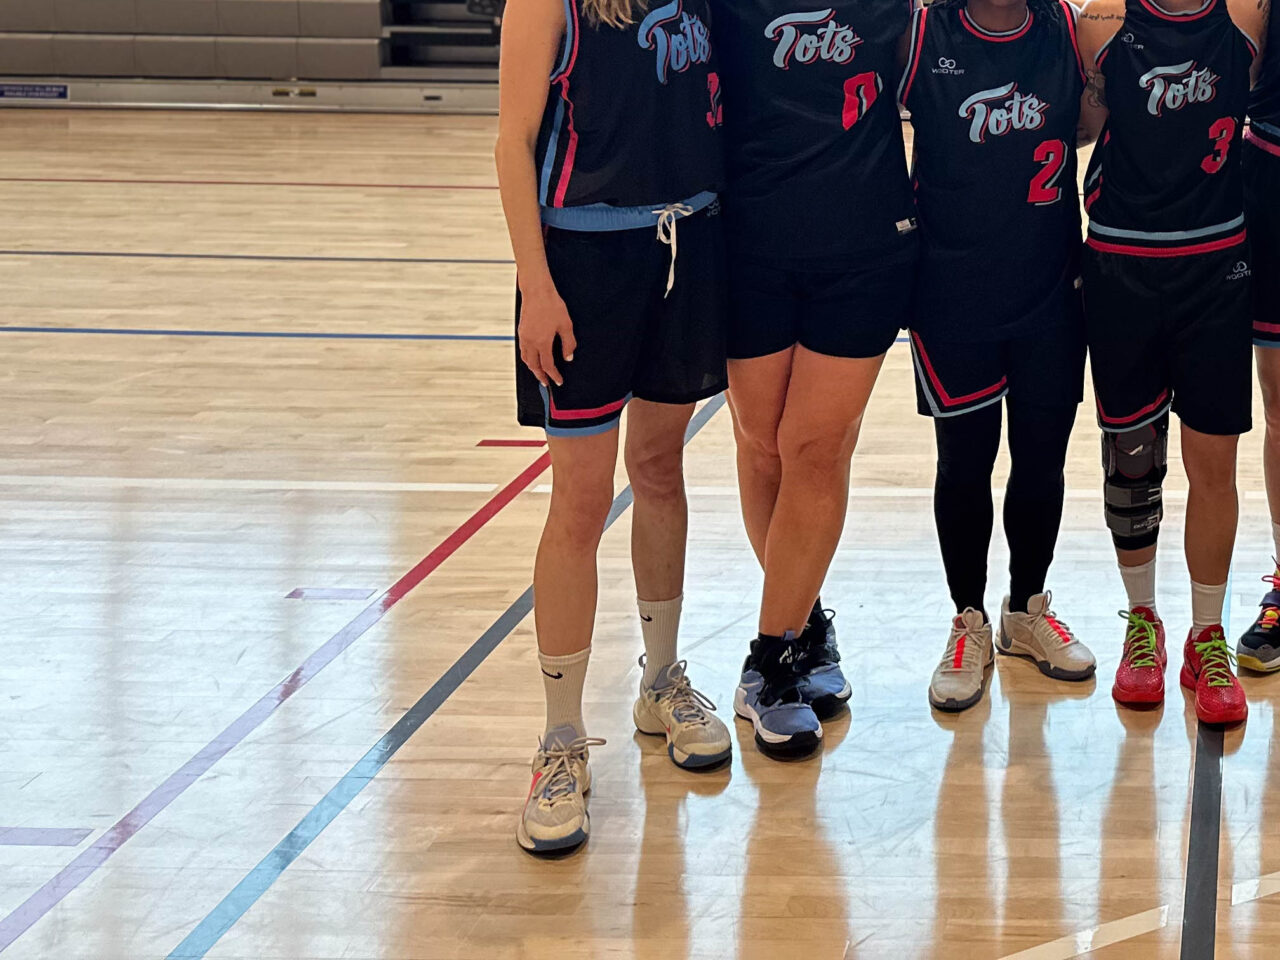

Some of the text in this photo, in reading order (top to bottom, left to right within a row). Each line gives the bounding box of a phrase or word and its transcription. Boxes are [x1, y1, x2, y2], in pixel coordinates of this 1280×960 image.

[764, 8, 864, 70] Tots
[958, 81, 1050, 144] Tots
[1139, 59, 1221, 117] Tots
[1027, 139, 1068, 206] 2
[1200, 116, 1238, 174] 3
[1226, 270, 1251, 281] WOOT
